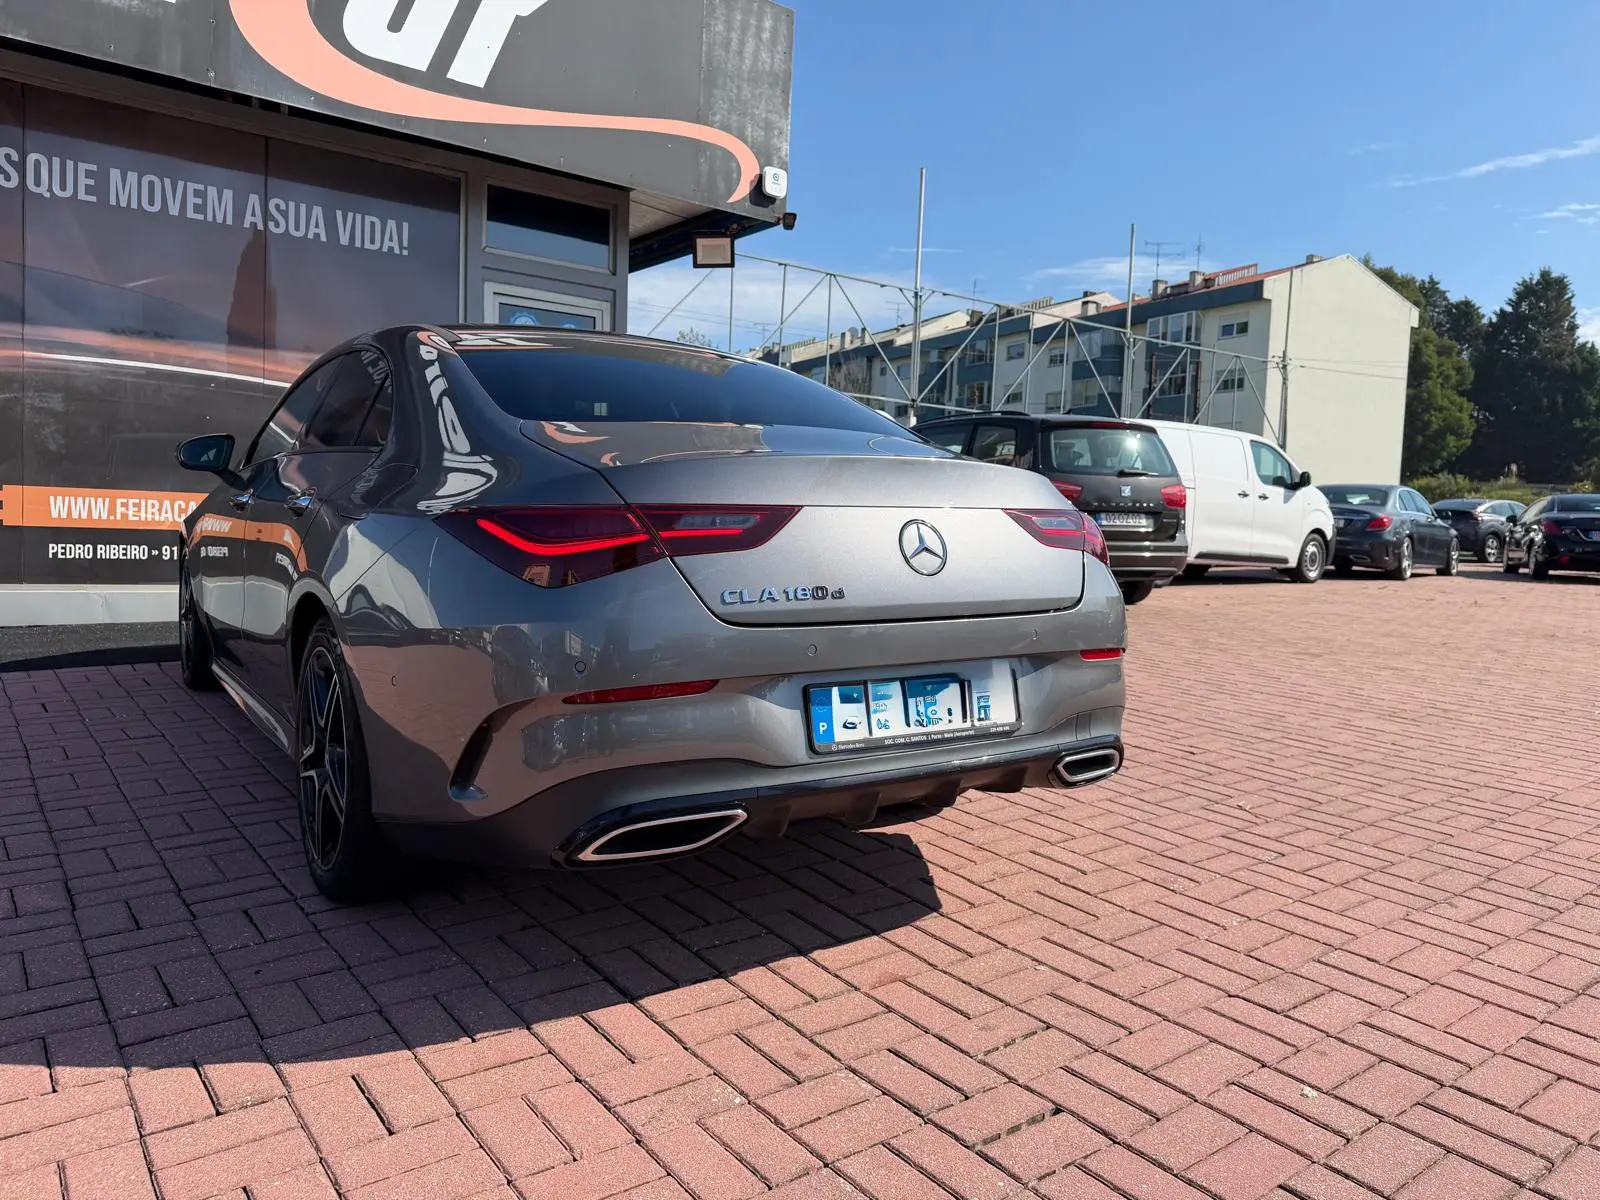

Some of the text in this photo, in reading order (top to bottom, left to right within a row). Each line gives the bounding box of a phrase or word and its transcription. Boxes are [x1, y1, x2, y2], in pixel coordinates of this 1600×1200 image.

[25, 152, 98, 203] QUE
[109, 167, 233, 226] MOVEM
[243, 193, 264, 231] A
[268, 198, 327, 242] SUA
[335, 209, 409, 256] VIDA!
[48, 543, 93, 559] PEDRO
[97, 544, 148, 560] RIBEIRO
[162, 545, 178, 560] 91
[720, 586, 780, 606] CLA
[783, 585, 828, 602] 180
[819, 722, 828, 735] P
